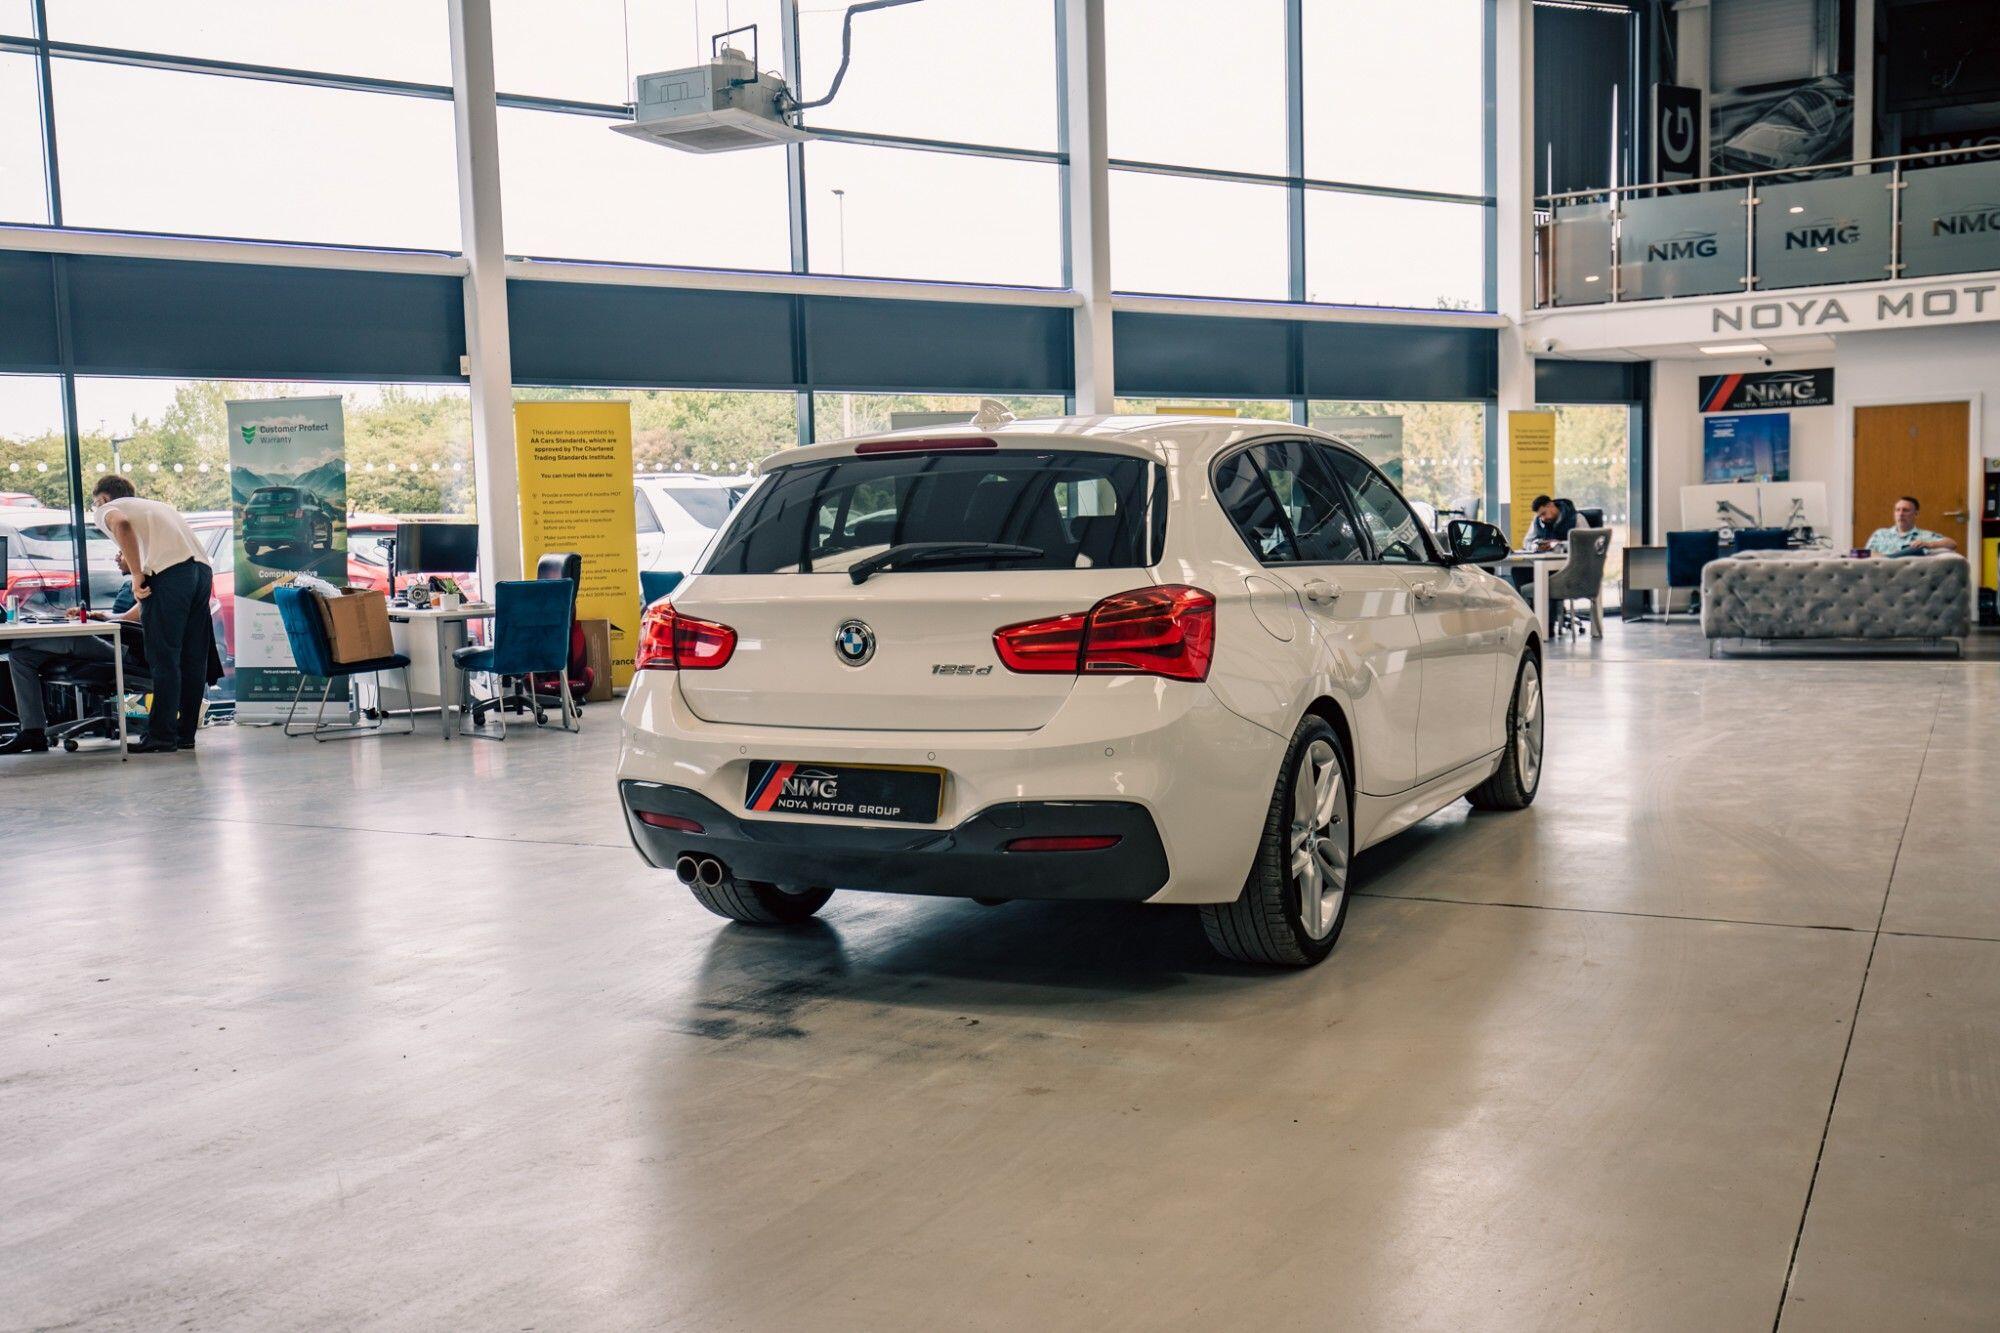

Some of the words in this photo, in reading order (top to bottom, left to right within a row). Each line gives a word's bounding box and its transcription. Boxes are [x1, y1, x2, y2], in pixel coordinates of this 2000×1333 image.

[1785, 225, 1860, 250] NMG
[1647, 240, 1718, 262] NMG
[1712, 298, 1850, 333] NOYA
[1877, 285, 1997, 321] MOT
[1744, 380, 1816, 402] NMG
[1733, 401, 1758, 409] NOYA
[1760, 400, 1792, 408] MOTOR
[1795, 397, 1828, 406] GROUP
[260, 425, 297, 434] Customer
[298, 423, 329, 432] Protect
[260, 436, 292, 444] Warranty
[612, 658, 636, 666] rance
[931, 664, 993, 675] 125d
[780, 777, 839, 798] NMG
[777, 799, 809, 809] NOYA
[812, 801, 854, 813] MOTOR
[858, 804, 901, 816] GROUP
